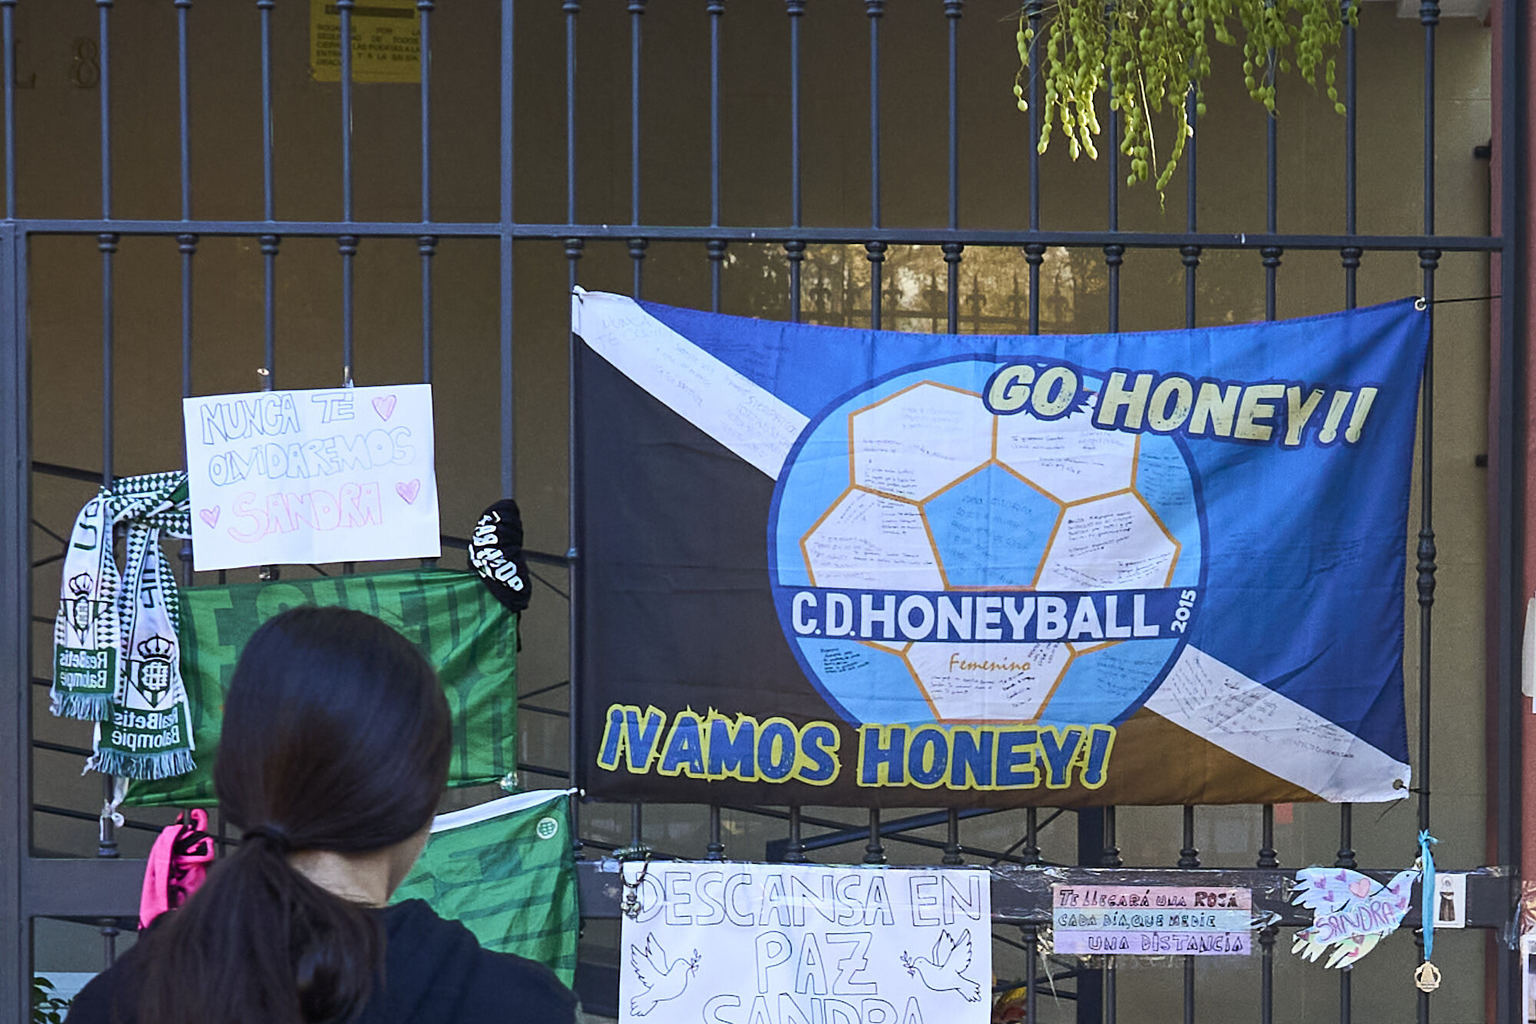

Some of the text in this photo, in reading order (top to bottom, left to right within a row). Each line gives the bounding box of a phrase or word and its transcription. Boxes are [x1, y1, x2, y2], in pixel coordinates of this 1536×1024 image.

[201, 391, 355, 446] NUNCA TE
[988, 364, 1378, 446] GO HONEY!!
[209, 425, 416, 487] OLVIDAREMOS
[228, 482, 384, 544] SANDRA
[1169, 589, 1197, 635] 2015
[949, 653, 1031, 673] Femenino
[860, 727, 1114, 787] HONEY!
[635, 871, 981, 927] DESCANSA EN
[1058, 913, 1097, 927] CADA
[1169, 912, 1217, 928] MEDIE
[1155, 894, 1187, 907] UNA
[1194, 891, 1239, 908] ROSA
[1315, 900, 1396, 942] SANDRA
[755, 930, 878, 996] PAZ
[1088, 936, 1130, 951] UNA
